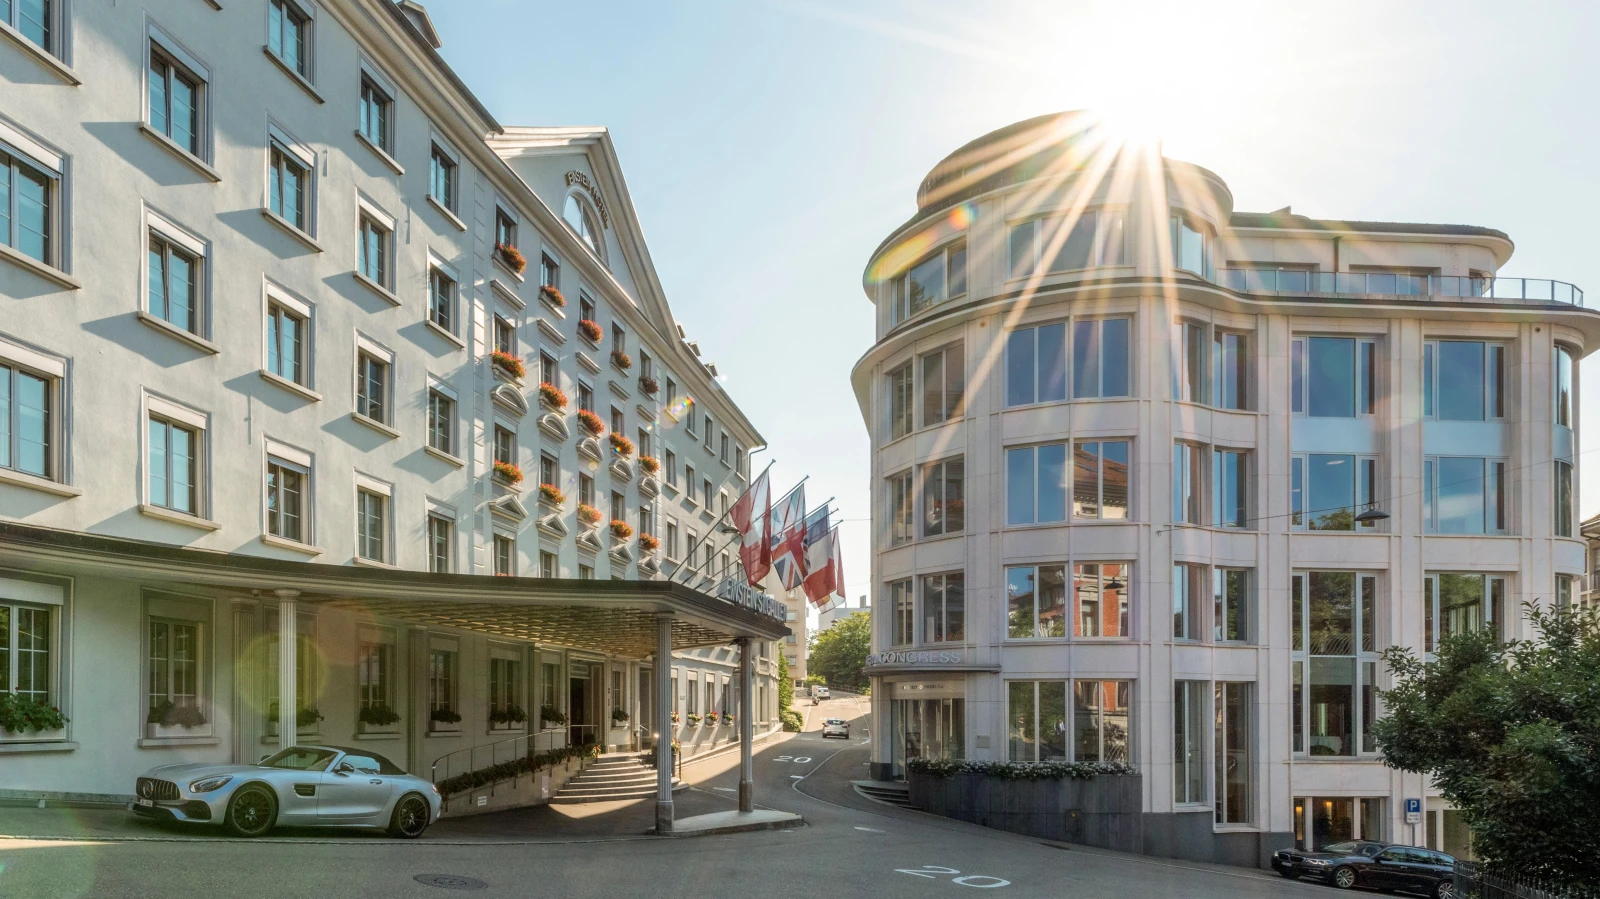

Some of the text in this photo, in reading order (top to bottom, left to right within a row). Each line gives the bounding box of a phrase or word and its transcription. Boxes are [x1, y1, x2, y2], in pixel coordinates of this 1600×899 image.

[880, 651, 960, 663] CONGRESS
[773, 755, 812, 763] 20
[893, 865, 1011, 888] 20
